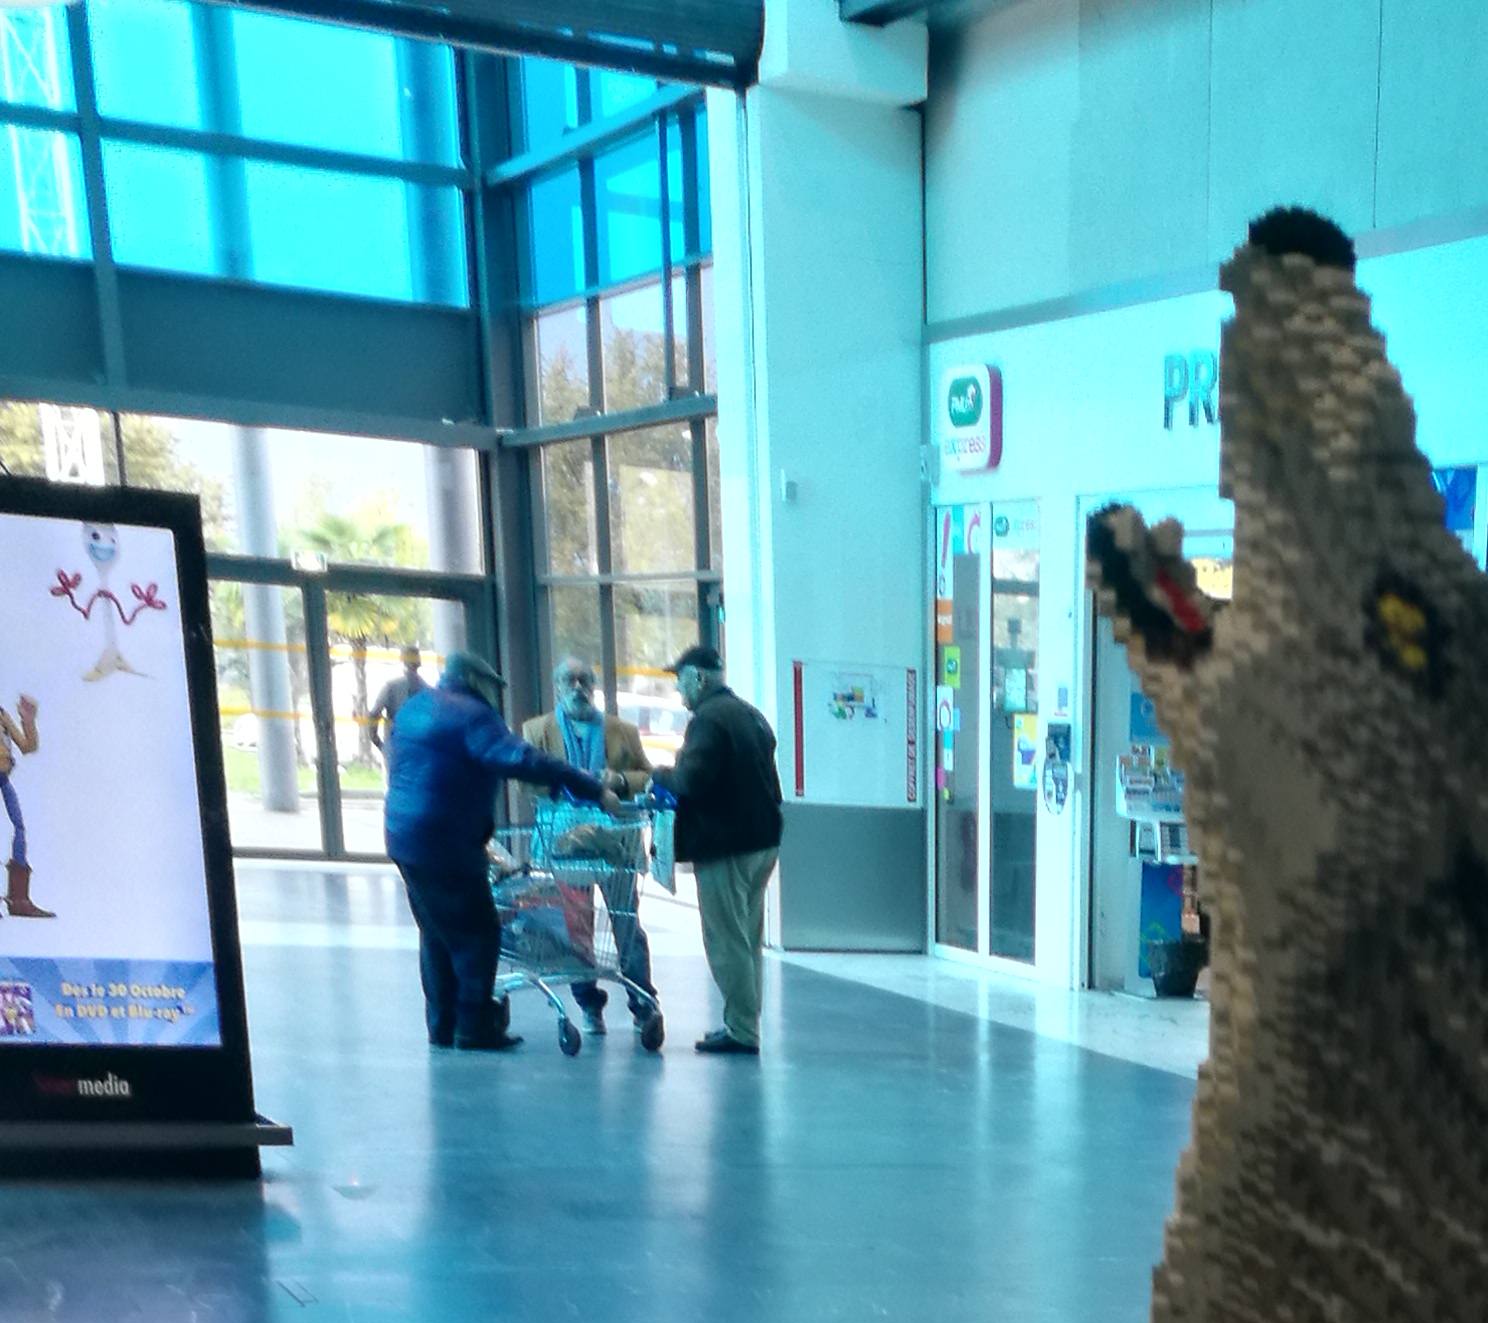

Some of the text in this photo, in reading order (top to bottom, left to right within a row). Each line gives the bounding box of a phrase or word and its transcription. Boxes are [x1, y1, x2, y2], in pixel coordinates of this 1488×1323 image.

[1163, 352, 1219, 430] PR
[944, 436, 987, 460] express
[108, 983, 127, 998] 30
[129, 983, 187, 999] Octobre
[76, 1004, 108, 1018] DVD
[109, 1005, 126, 1019] et
[77, 1071, 131, 1096] media
